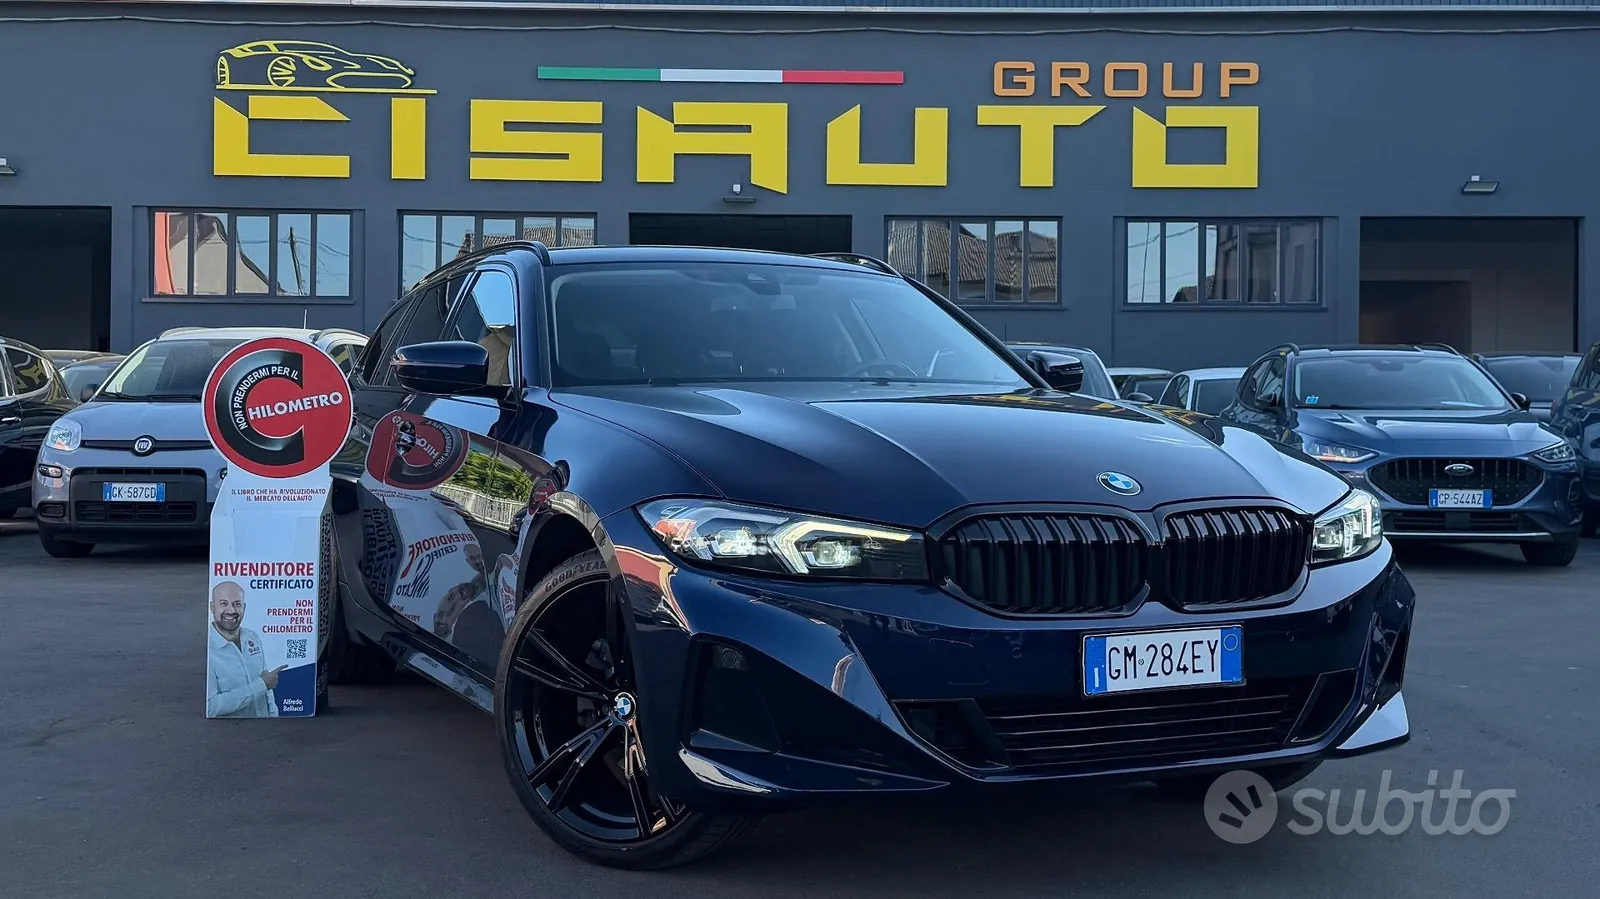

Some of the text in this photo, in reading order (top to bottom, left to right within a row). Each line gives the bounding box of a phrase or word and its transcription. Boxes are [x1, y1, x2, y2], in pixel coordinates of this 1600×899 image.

[993, 61, 1260, 98] GROUP
[213, 95, 1259, 194] CISAUTO
[233, 366, 299, 430] NON PRENDERMI PER IL
[214, 562, 314, 576] RIVENDITORE
[249, 579, 314, 590] CERTIFICATO
[267, 608, 314, 616] PRENDERMI
[262, 625, 314, 633] CHILOMETRO
